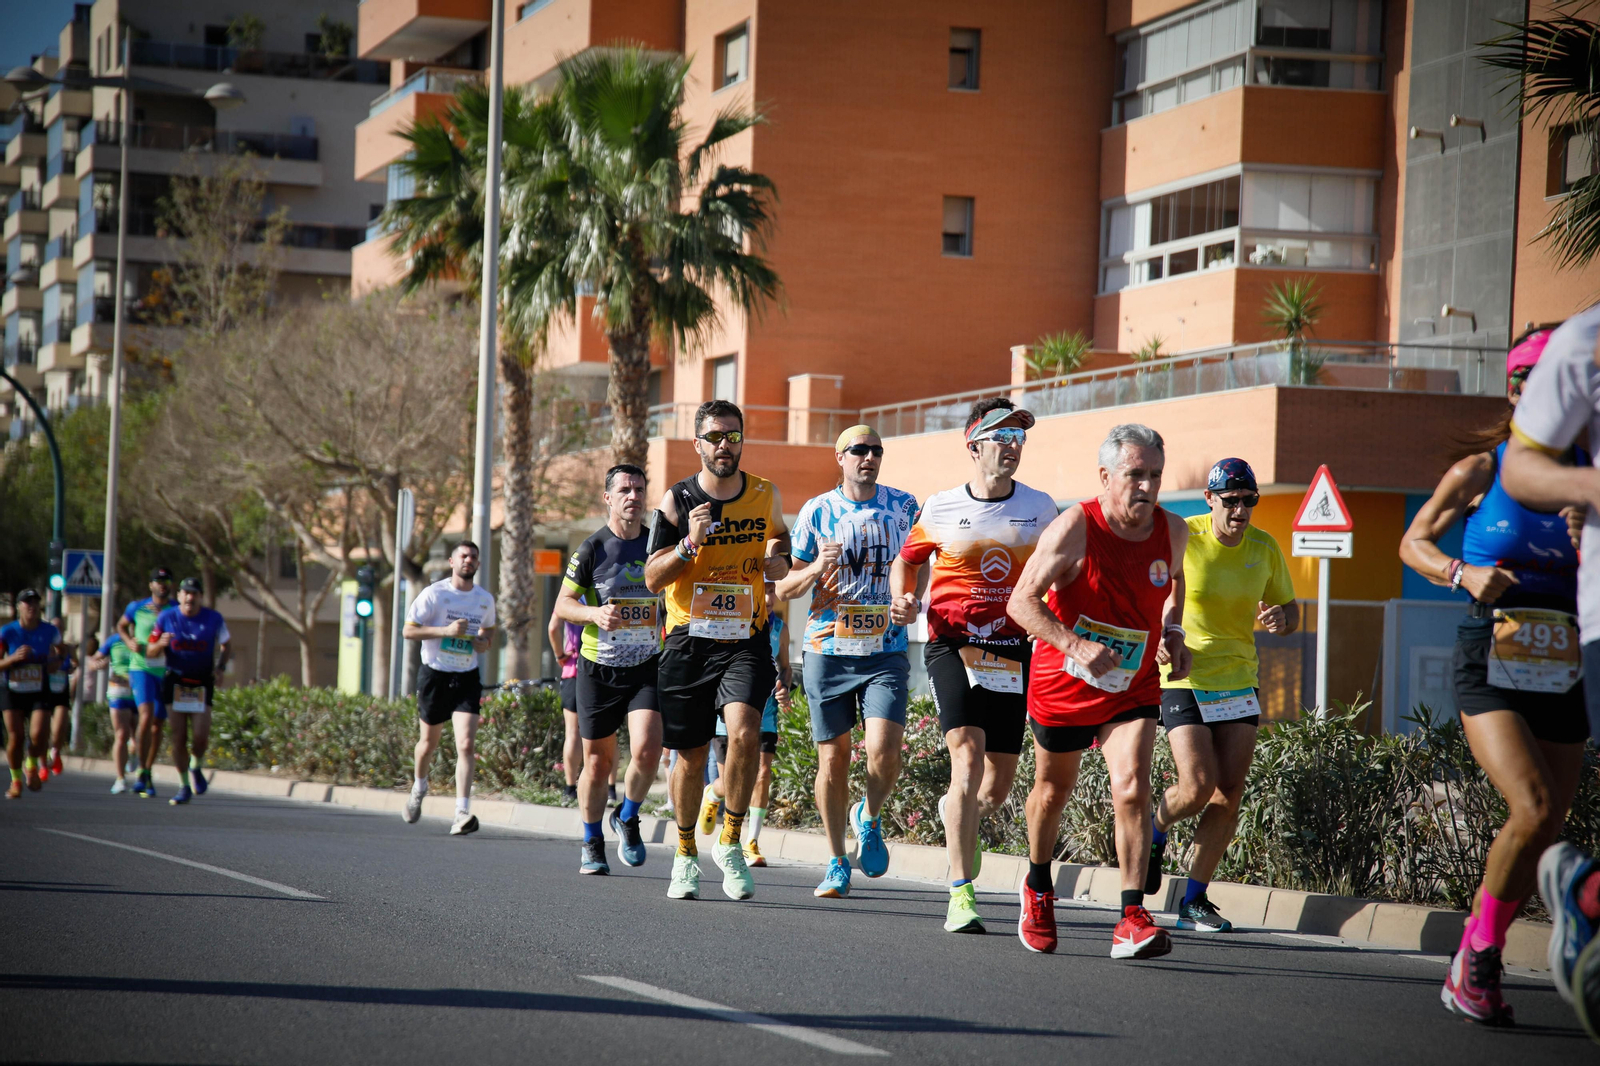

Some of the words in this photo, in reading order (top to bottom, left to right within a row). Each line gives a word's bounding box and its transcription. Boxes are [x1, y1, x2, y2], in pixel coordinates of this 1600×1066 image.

[1486, 526, 1517, 535] SPIRAL
[970, 586, 1014, 594] CITROË
[711, 594, 735, 610] 48
[620, 606, 650, 620] 686
[842, 614, 884, 629] 1550
[1513, 622, 1568, 650] 493
